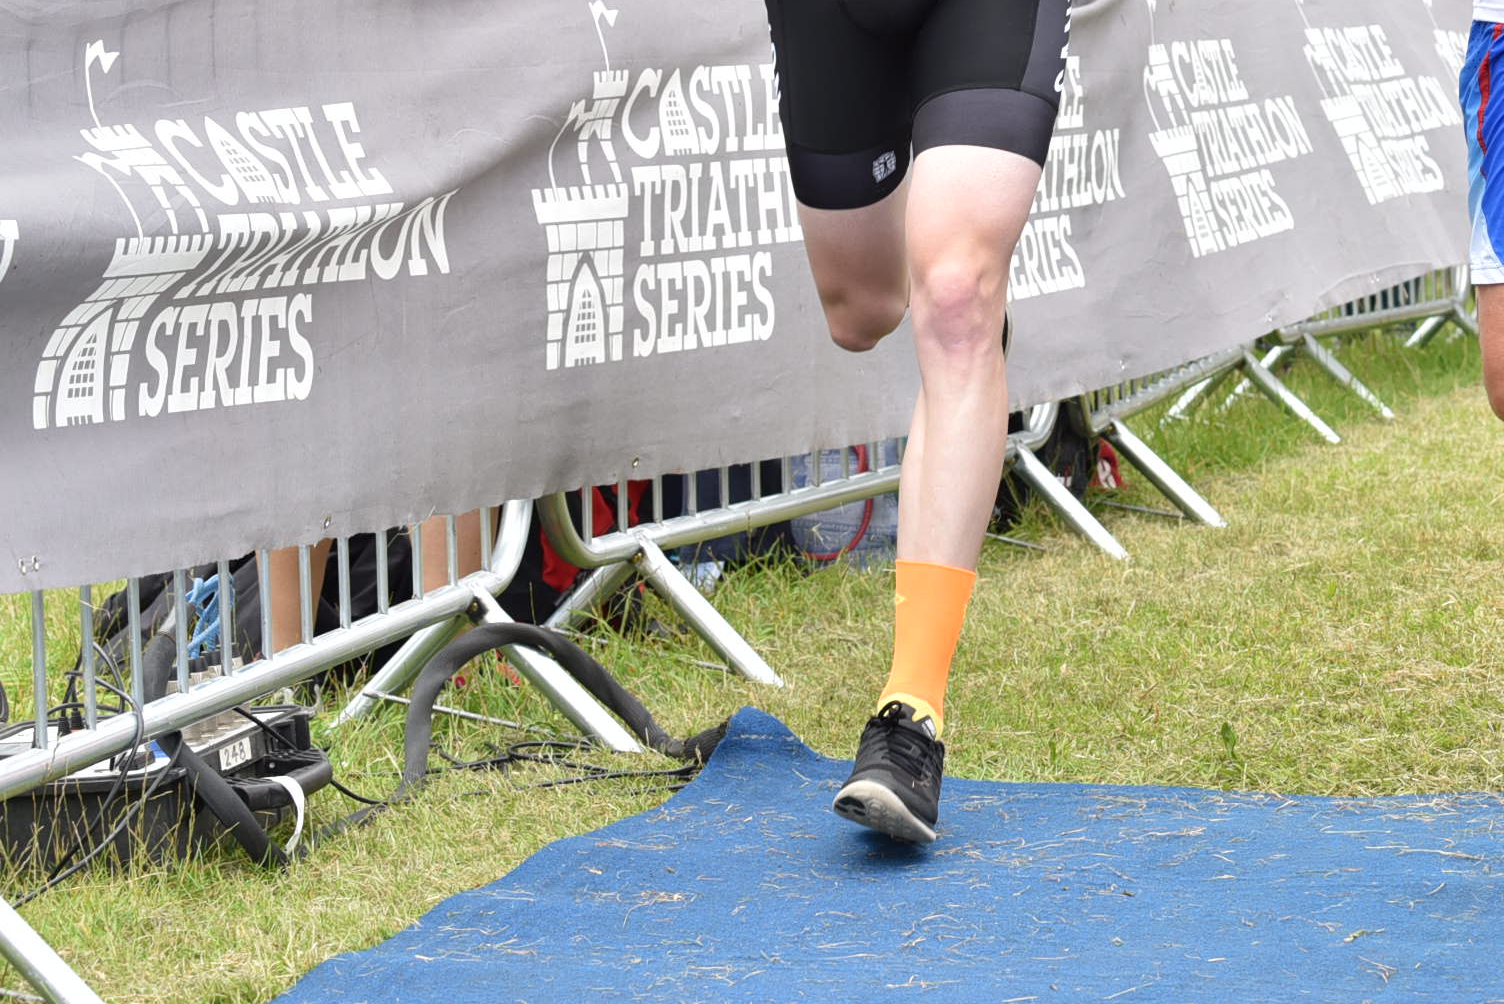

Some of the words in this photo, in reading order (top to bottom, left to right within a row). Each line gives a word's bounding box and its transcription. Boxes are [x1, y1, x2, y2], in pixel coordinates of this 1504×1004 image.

[1171, 38, 1249, 108] CASTLE
[1323, 24, 1405, 83] CASTLE
[155, 101, 394, 206] CASTLE
[1191, 95, 1314, 178] TRIATHLON
[1381, 134, 1445, 194] SERIES
[631, 156, 805, 257] TRIATHL
[1210, 168, 1295, 247] SERIES
[1006, 214, 1086, 303] ERIES
[633, 250, 776, 358] SERIES
[138, 293, 314, 417] SERIES
[223, 740, 247, 768] 248
